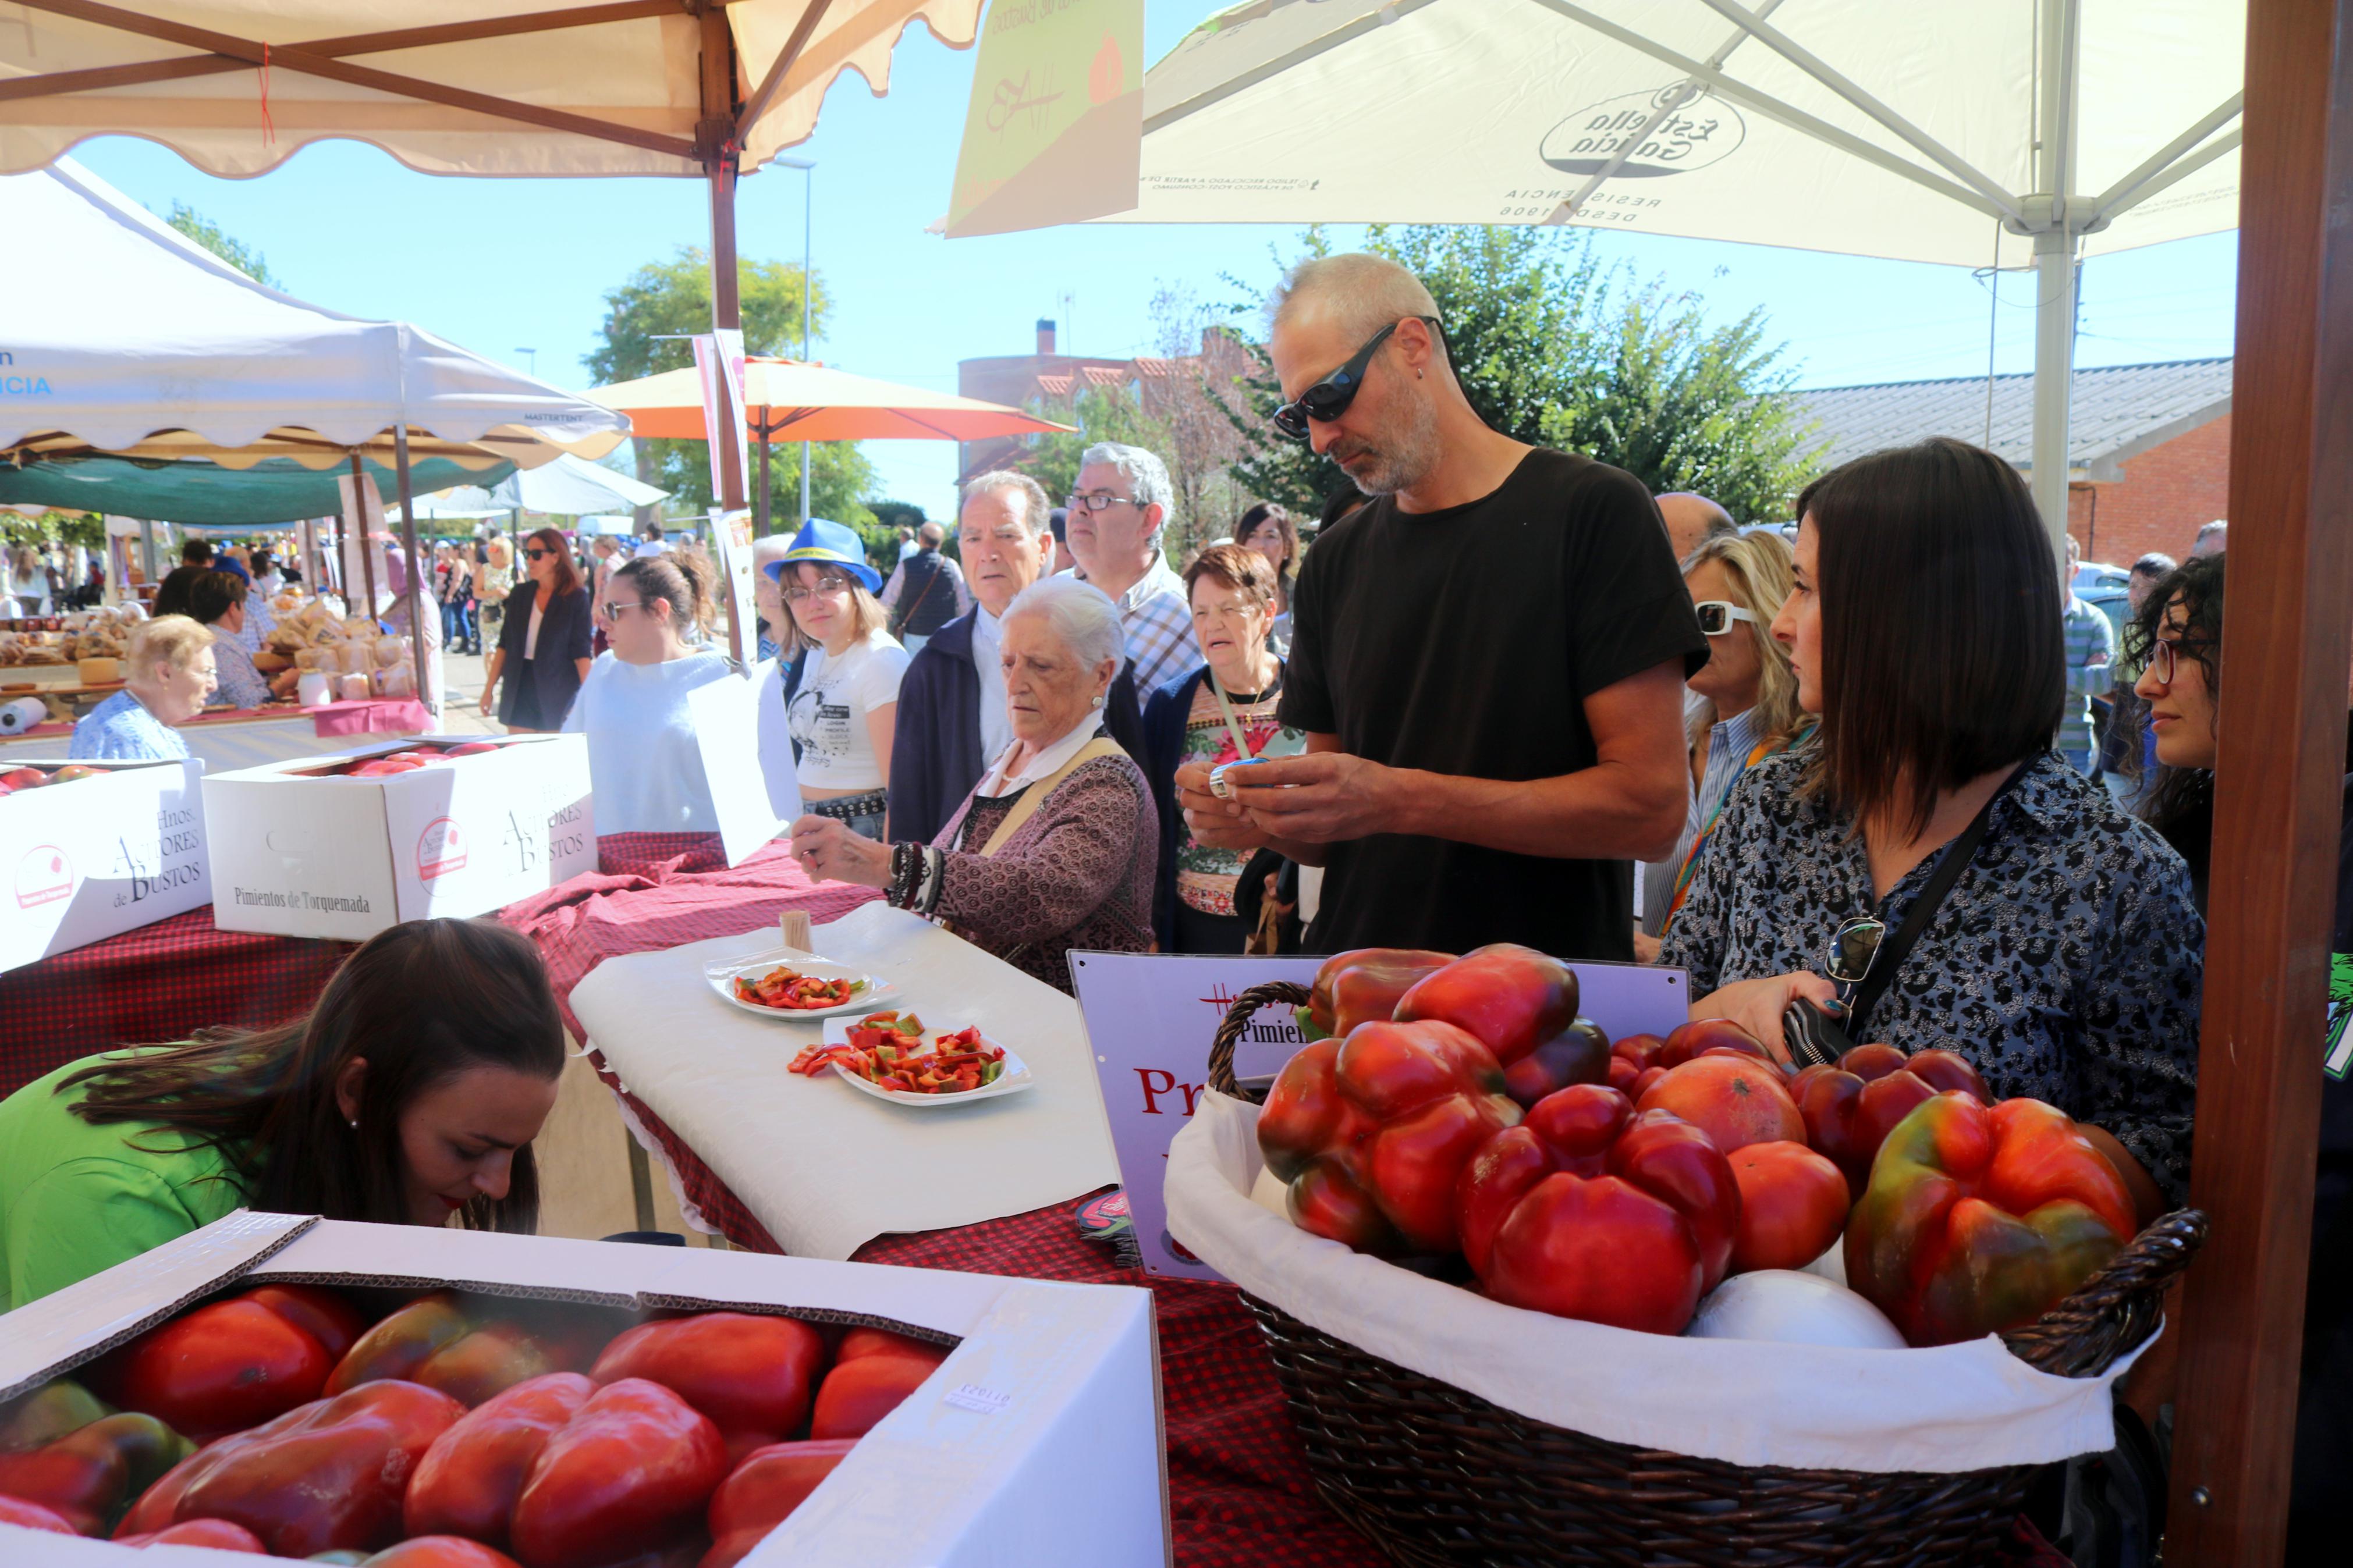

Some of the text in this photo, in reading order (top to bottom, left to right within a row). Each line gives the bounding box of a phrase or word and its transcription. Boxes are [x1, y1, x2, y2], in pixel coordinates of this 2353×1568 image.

[524, 413, 584, 422] MASTERTENT
[112, 893, 128, 908] de
[234, 887, 371, 913] Pimientos de Torquemada
[1241, 1019, 1309, 1044] Pimien
[1133, 1068, 1205, 1117] Pr
